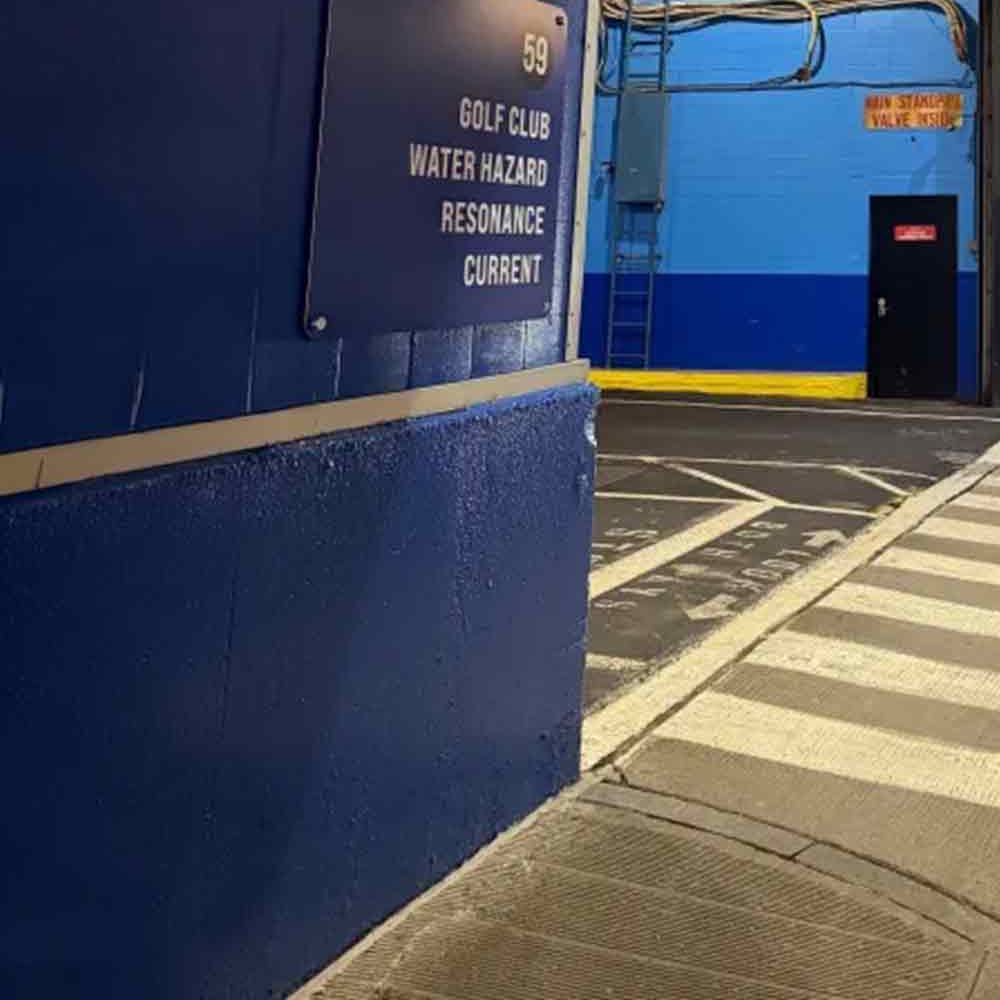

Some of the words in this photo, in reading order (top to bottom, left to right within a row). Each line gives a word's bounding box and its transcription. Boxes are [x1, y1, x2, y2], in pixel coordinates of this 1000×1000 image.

[522, 33, 548, 75] 59
[459, 97, 504, 133] GOLF
[509, 106, 551, 140] CLUB
[409, 143, 475, 180] WATER
[480, 152, 547, 187] HAZARD
[441, 201, 544, 235] RESONANCE
[464, 254, 542, 286] CURRENT
